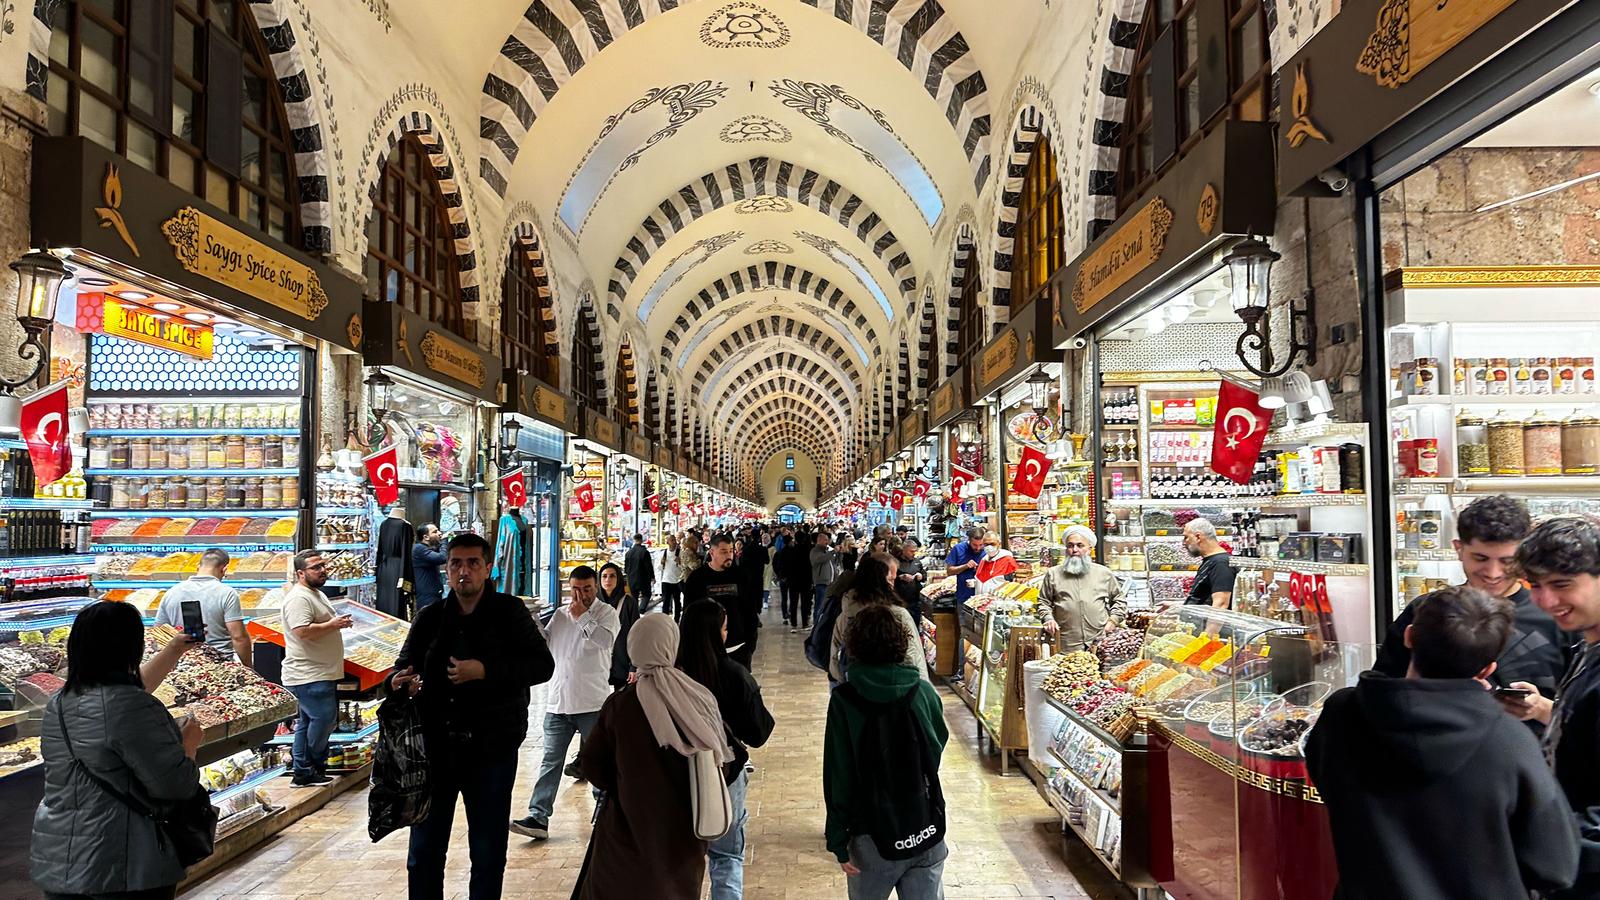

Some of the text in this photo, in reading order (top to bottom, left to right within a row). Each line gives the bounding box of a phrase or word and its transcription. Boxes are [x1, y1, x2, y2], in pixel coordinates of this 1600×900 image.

[1200, 195, 1213, 224] 79
[204, 234, 304, 301] Saygı Spice Shop
[119, 307, 202, 350] SAYGI SPICE
[894, 824, 937, 850] adidas
